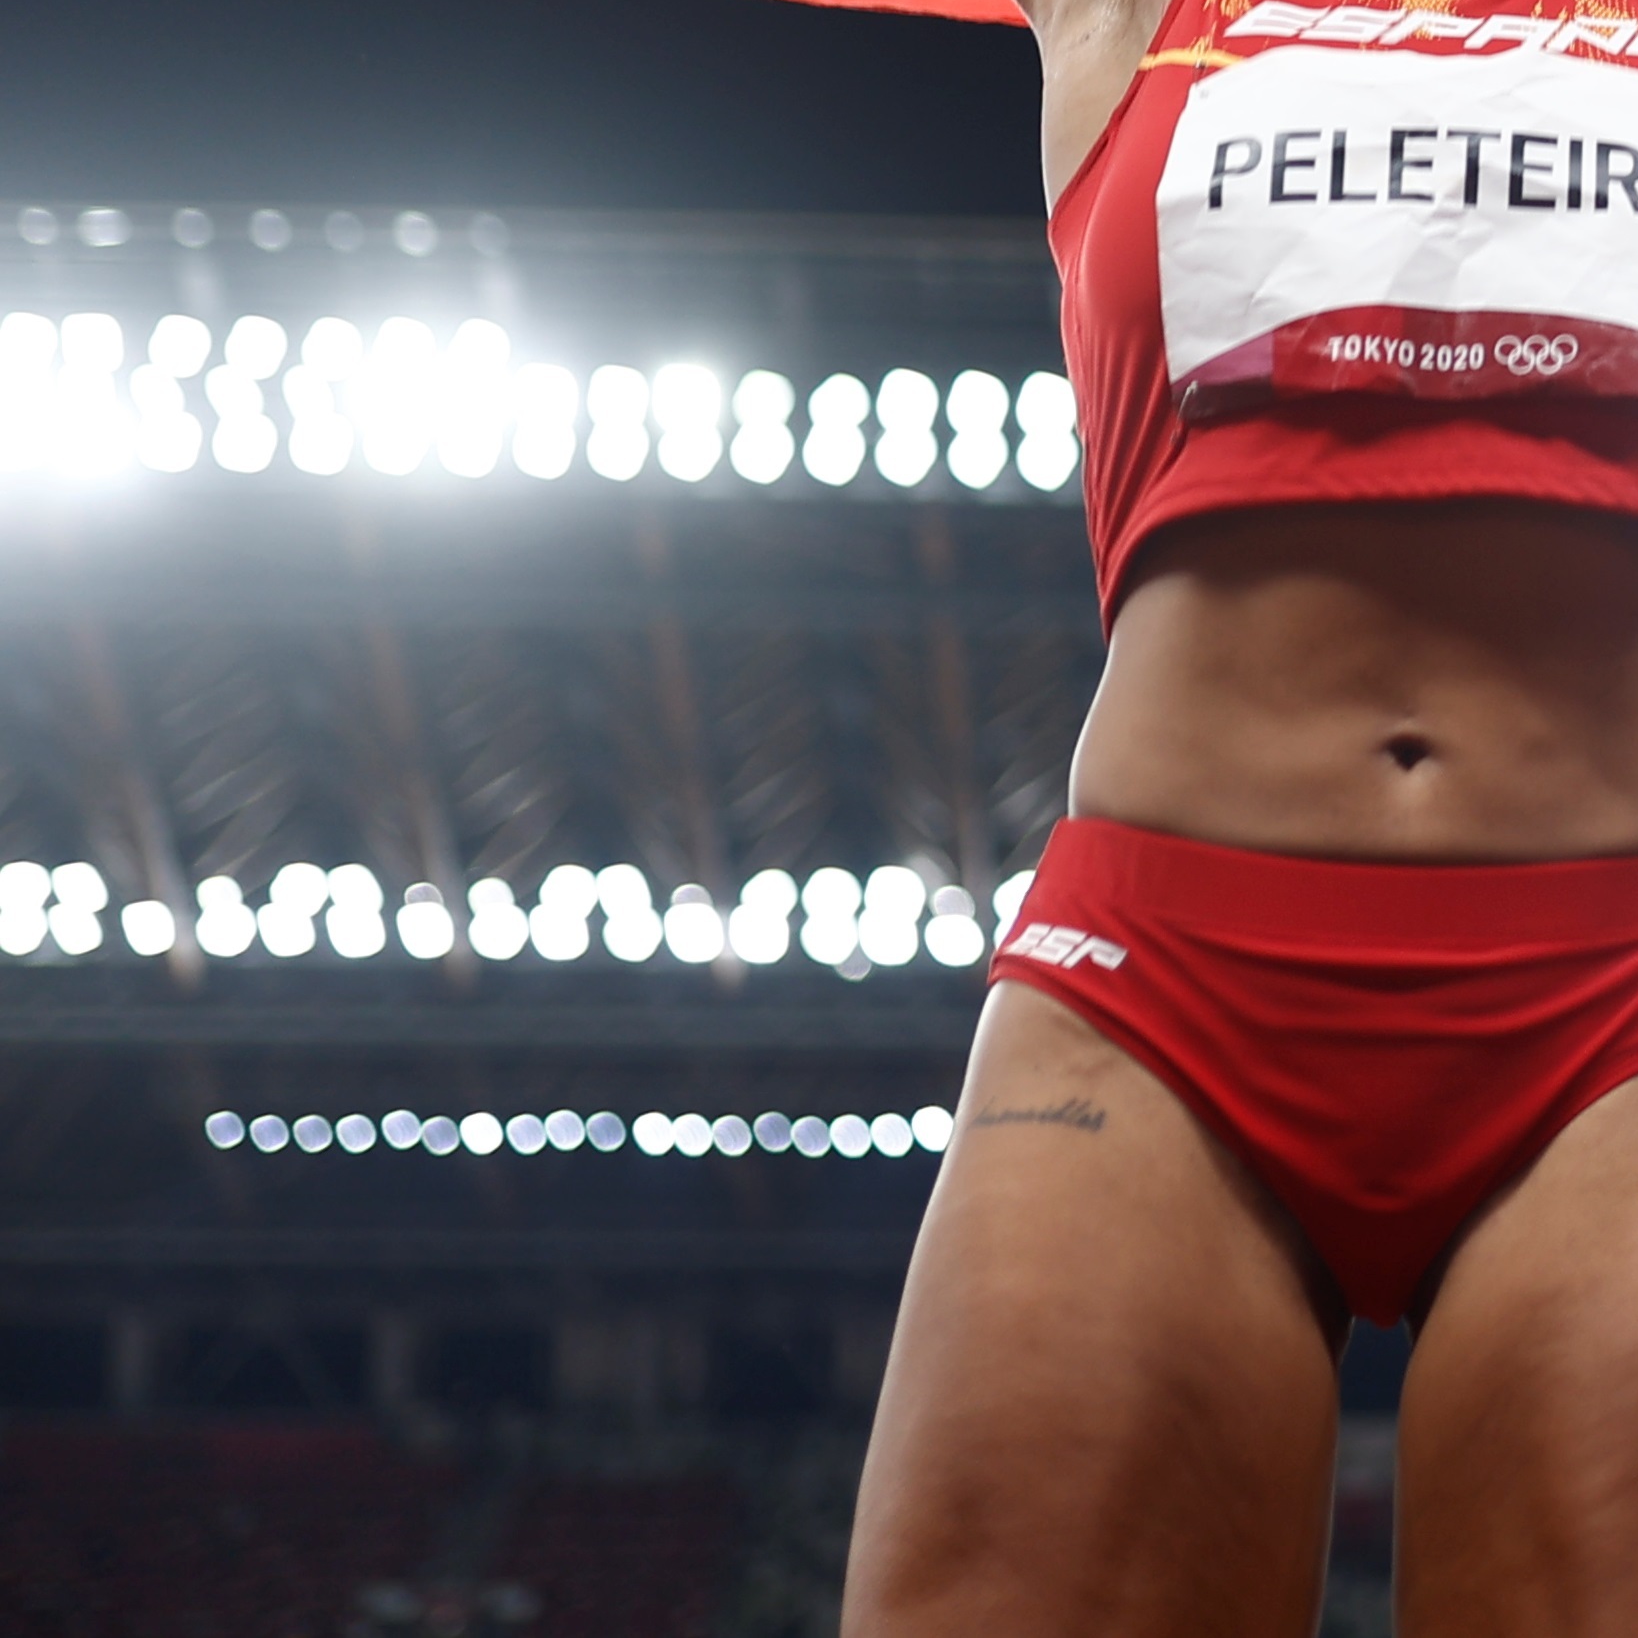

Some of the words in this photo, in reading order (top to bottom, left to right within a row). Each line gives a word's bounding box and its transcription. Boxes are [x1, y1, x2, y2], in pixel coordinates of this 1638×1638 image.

[1328, 334, 1415, 368] TOKYO
[1419, 343, 1485, 372] 2020
[1004, 923, 1128, 970] ESP
